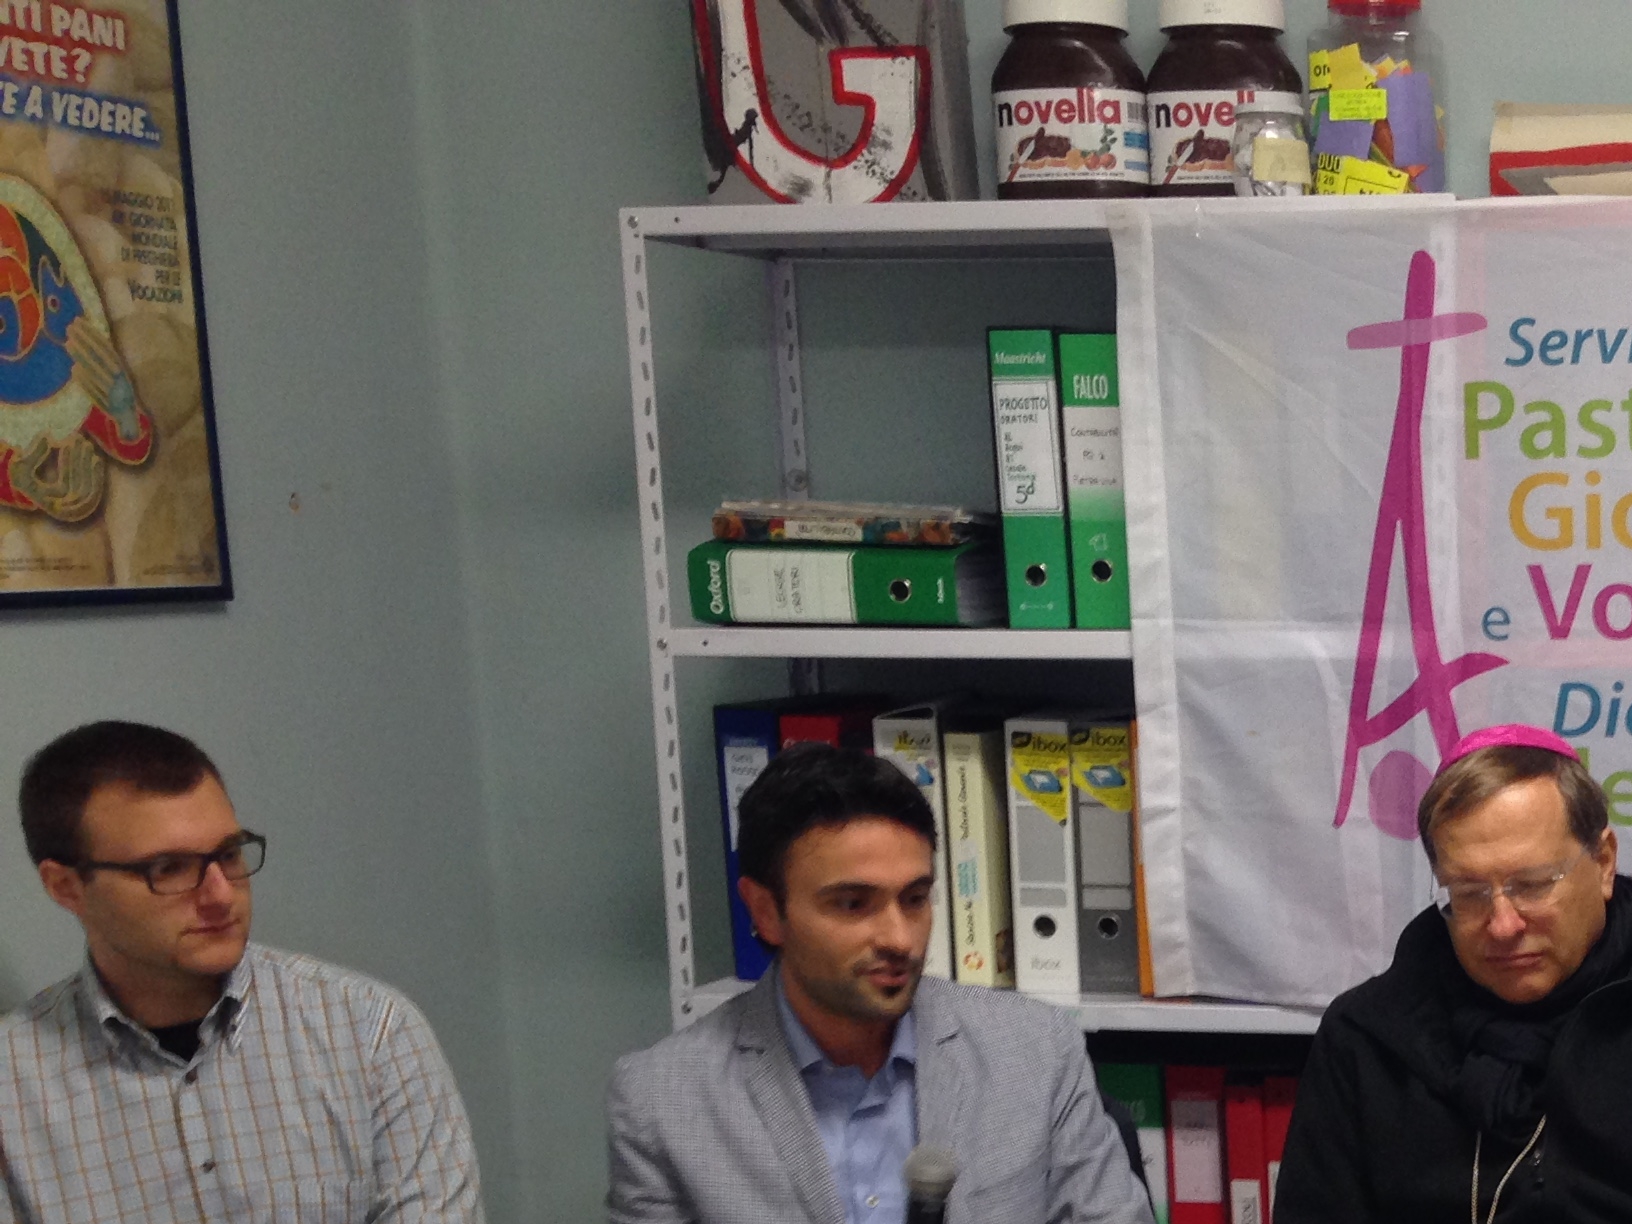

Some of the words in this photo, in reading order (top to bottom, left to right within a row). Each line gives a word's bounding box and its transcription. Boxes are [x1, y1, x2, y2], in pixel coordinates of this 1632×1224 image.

[51, 4, 126, 50] PANI
[0, 81, 19, 115] E
[24, 85, 44, 119] A
[998, 86, 1121, 128] novella
[994, 351, 1047, 366] Maastricht
[1073, 374, 1109, 400] FALCO
[999, 395, 1049, 412] PROGETTO
[707, 559, 725, 615] Oxford
[1482, 606, 1512, 643] e
[1031, 735, 1067, 753] ibox
[1090, 730, 1126, 747] ibox
